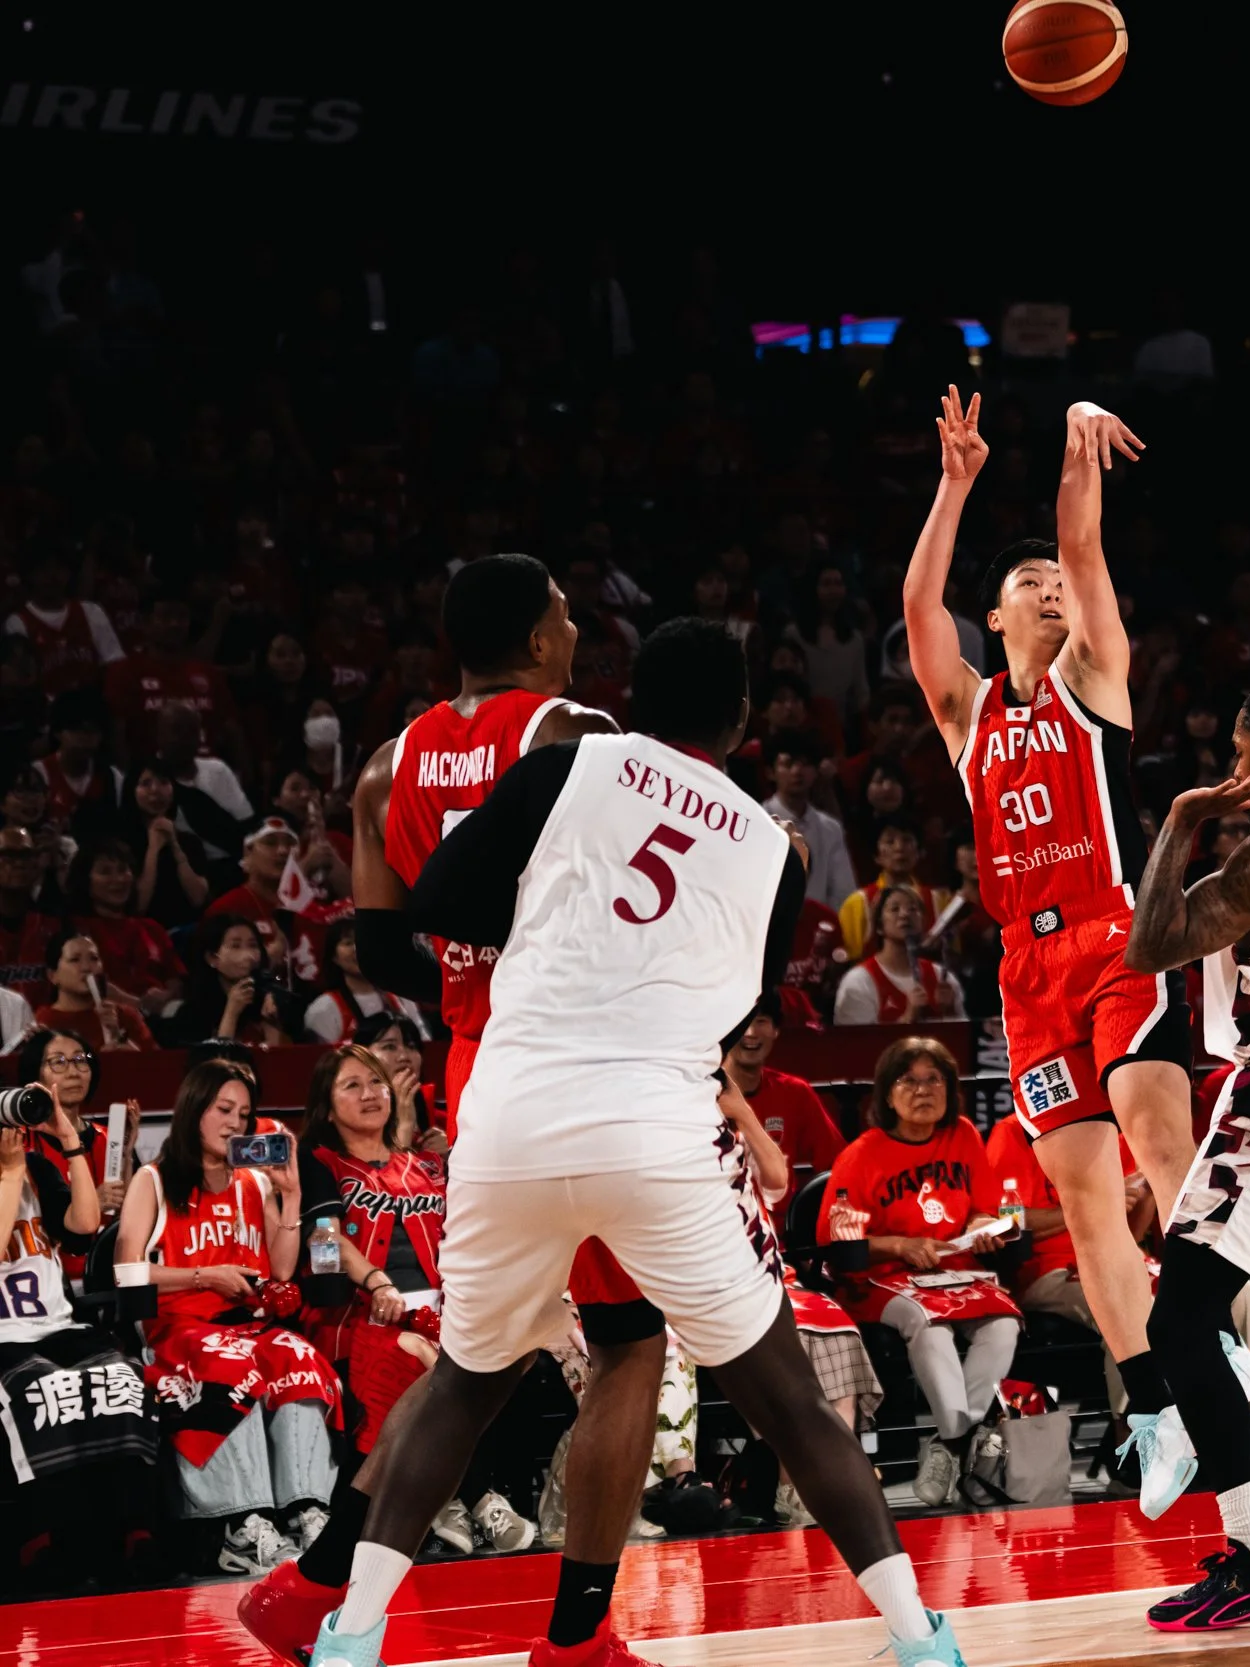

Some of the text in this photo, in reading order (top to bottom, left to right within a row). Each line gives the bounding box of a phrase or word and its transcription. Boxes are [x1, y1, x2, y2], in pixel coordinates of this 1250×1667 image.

[0, 81, 364, 144] IRLINES
[417, 744, 495, 788] HACHIMRA
[981, 720, 1068, 777] JAPAN
[616, 758, 751, 842] SEYDOU
[1000, 782, 1053, 833] 30
[612, 822, 697, 925] 5
[1013, 836, 1094, 873] SoftBank
[338, 1176, 446, 1222] Japan
[879, 1160, 971, 1208] JAPAN
[183, 1220, 262, 1258] JAPAN
